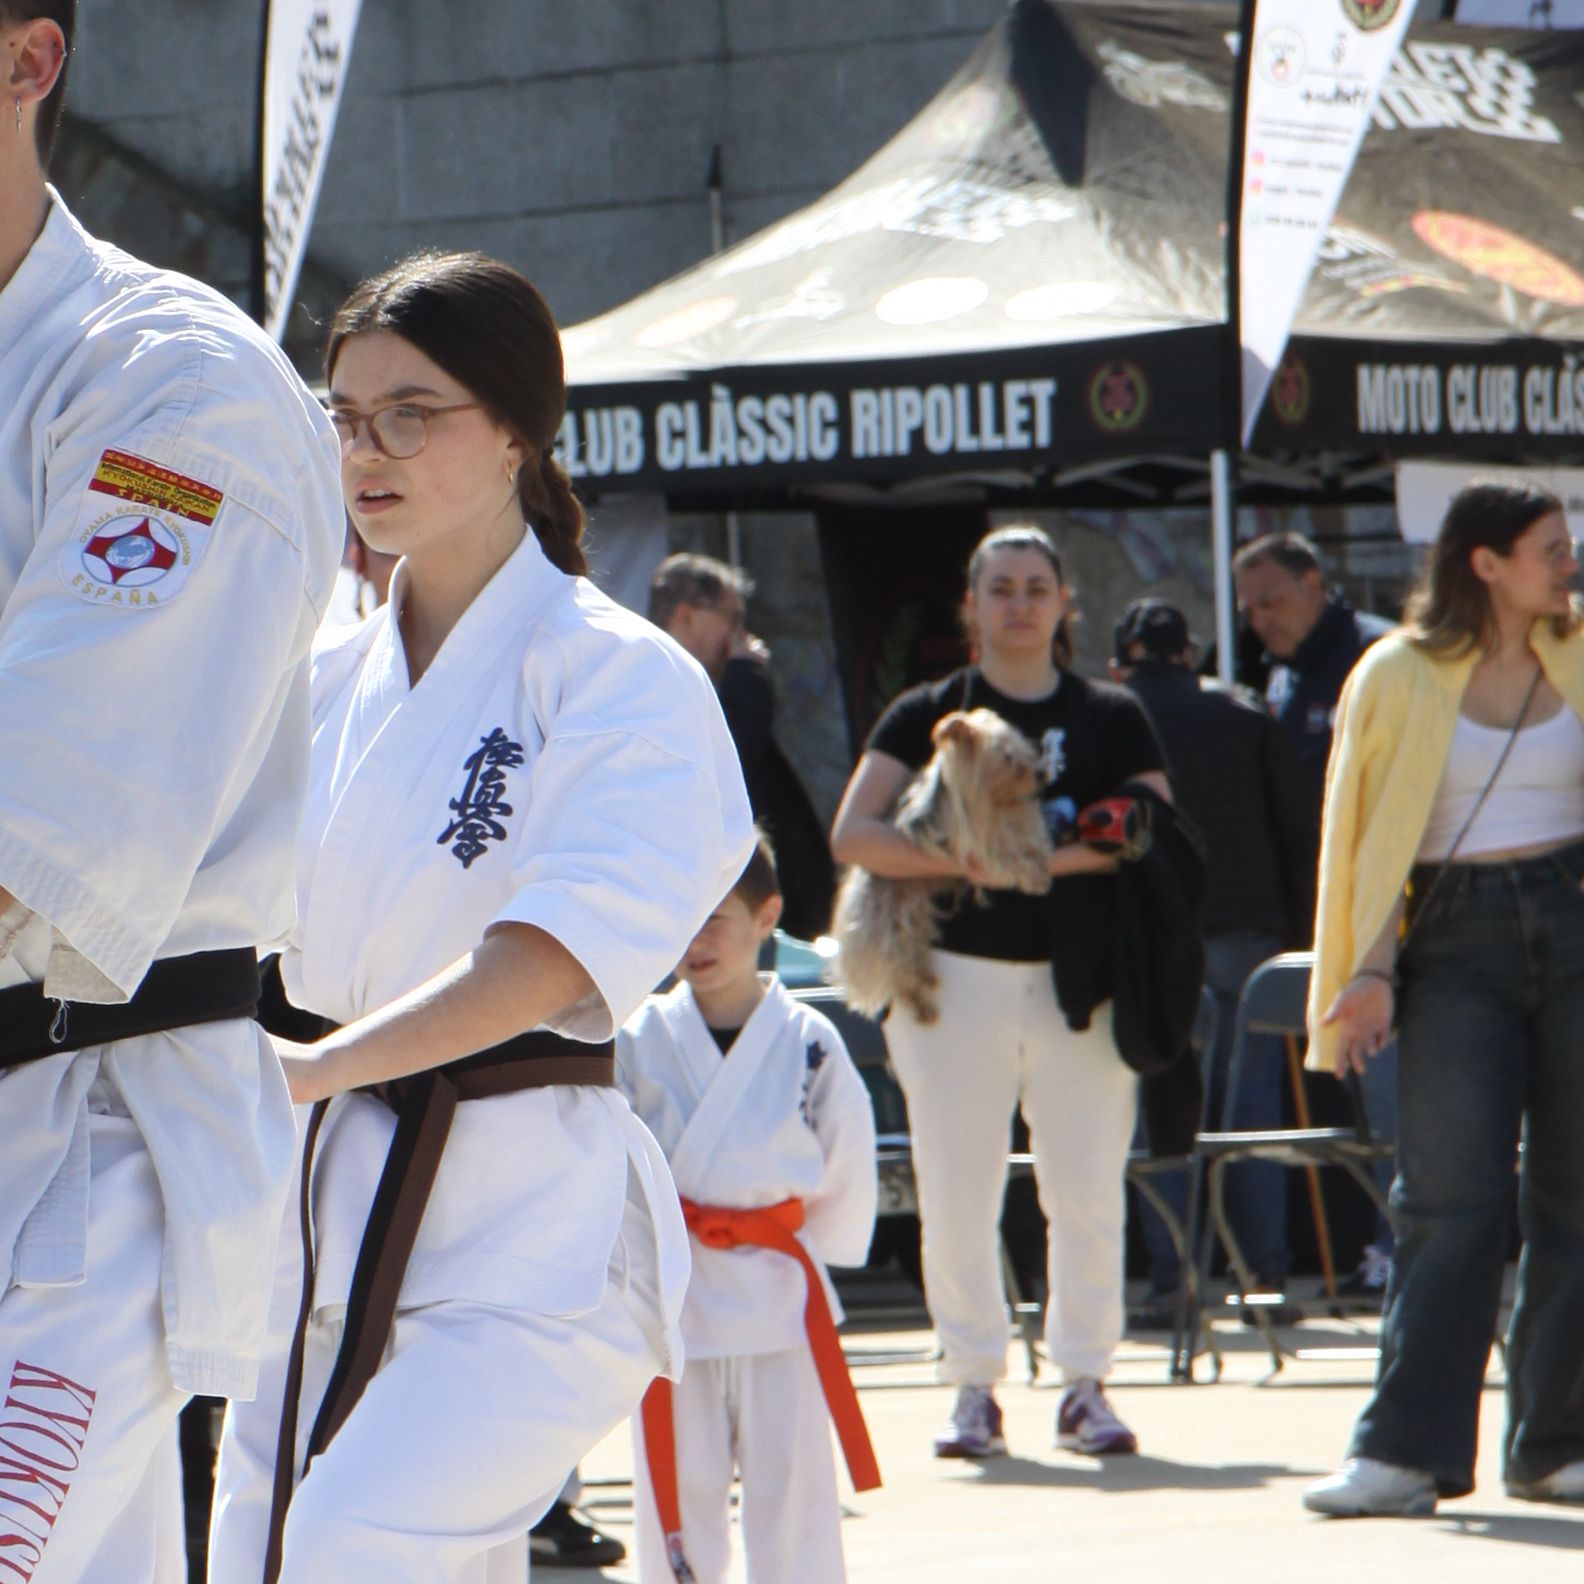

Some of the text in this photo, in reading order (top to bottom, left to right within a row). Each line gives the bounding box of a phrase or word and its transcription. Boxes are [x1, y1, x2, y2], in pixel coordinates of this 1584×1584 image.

[655, 382, 839, 471] CLÀSSIC
[850, 377, 1056, 459] RIPOLLET
[1356, 362, 1442, 434] MOTO
[1447, 363, 1519, 434] CLUB
[71, 573, 159, 606] ESPAÑA
